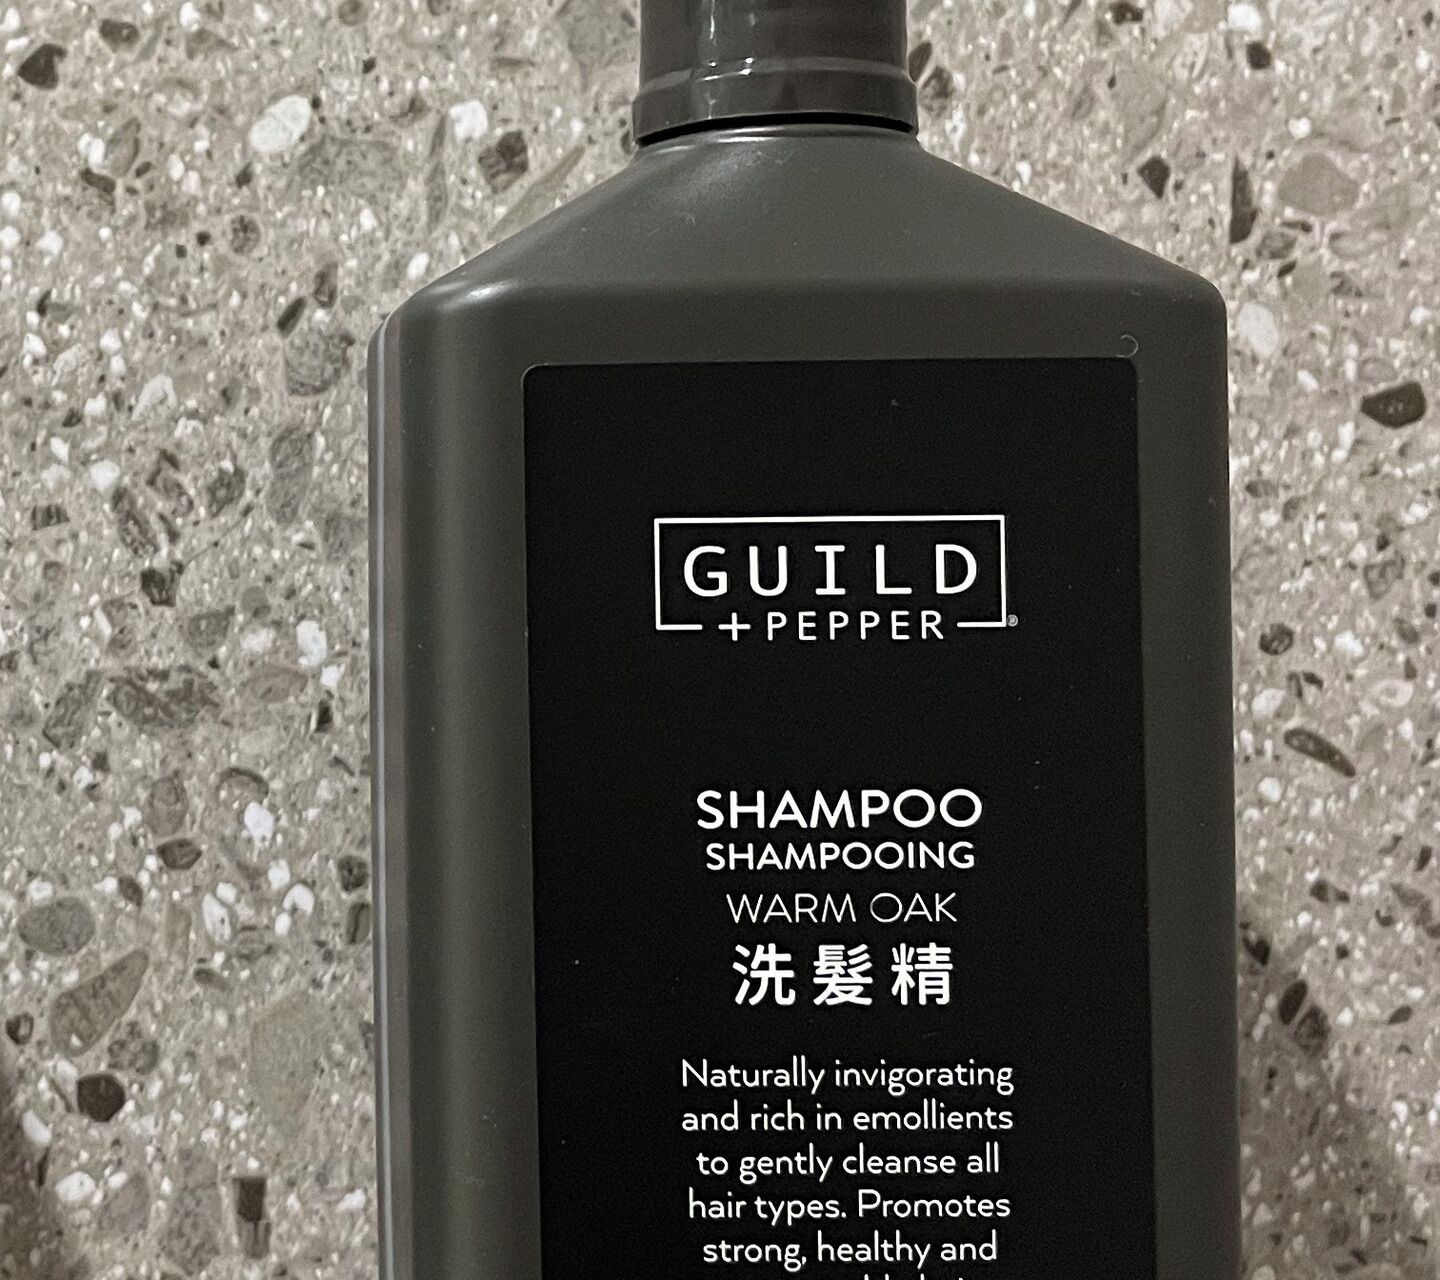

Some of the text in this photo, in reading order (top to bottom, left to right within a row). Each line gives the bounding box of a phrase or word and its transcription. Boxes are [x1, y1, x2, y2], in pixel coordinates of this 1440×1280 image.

[683, 543, 978, 598] GUILD
[696, 788, 983, 830] SHAMPOO
[705, 840, 975, 871] SHAMPOOING
[725, 891, 958, 924] WARM OAK
[732, 941, 954, 1006] 洗髮精
[681, 1054, 1015, 1097] Naturally invigorating
[681, 1097, 1014, 1132] and rich in emollients
[695, 1140, 1000, 1185] to gently cleanse all
[688, 1186, 1011, 1227] hair types. Promotes
[702, 1228, 998, 1273] strong, healthy and
